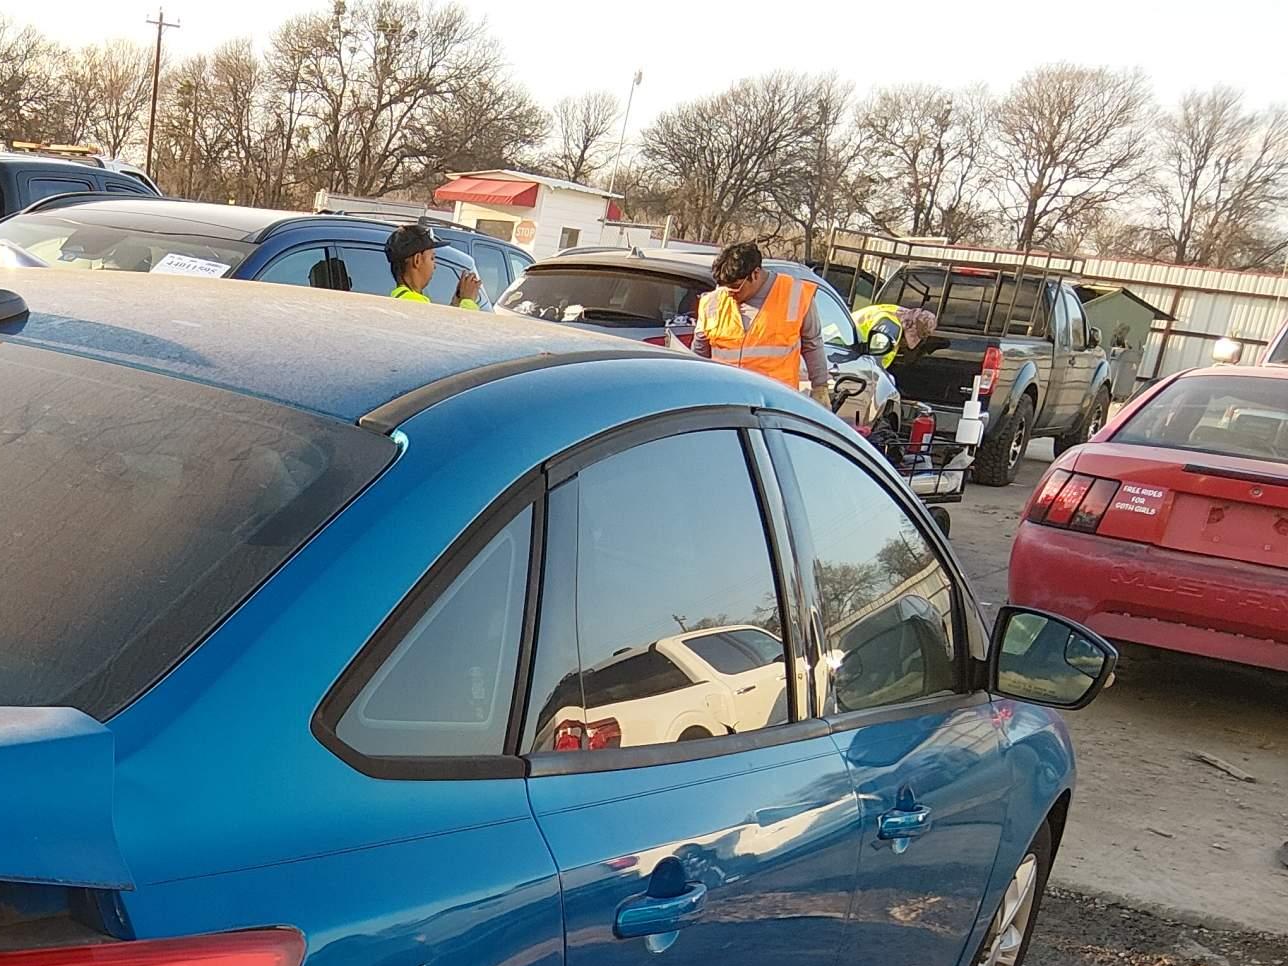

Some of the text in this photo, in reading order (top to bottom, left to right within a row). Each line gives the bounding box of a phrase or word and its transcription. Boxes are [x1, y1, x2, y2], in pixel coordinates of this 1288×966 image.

[516, 226, 536, 237] STOP
[1123, 485, 1163, 498] FREE RIDES
[1131, 496, 1146, 505] FOR
[1115, 502, 1156, 515] GOTH GIRLS
